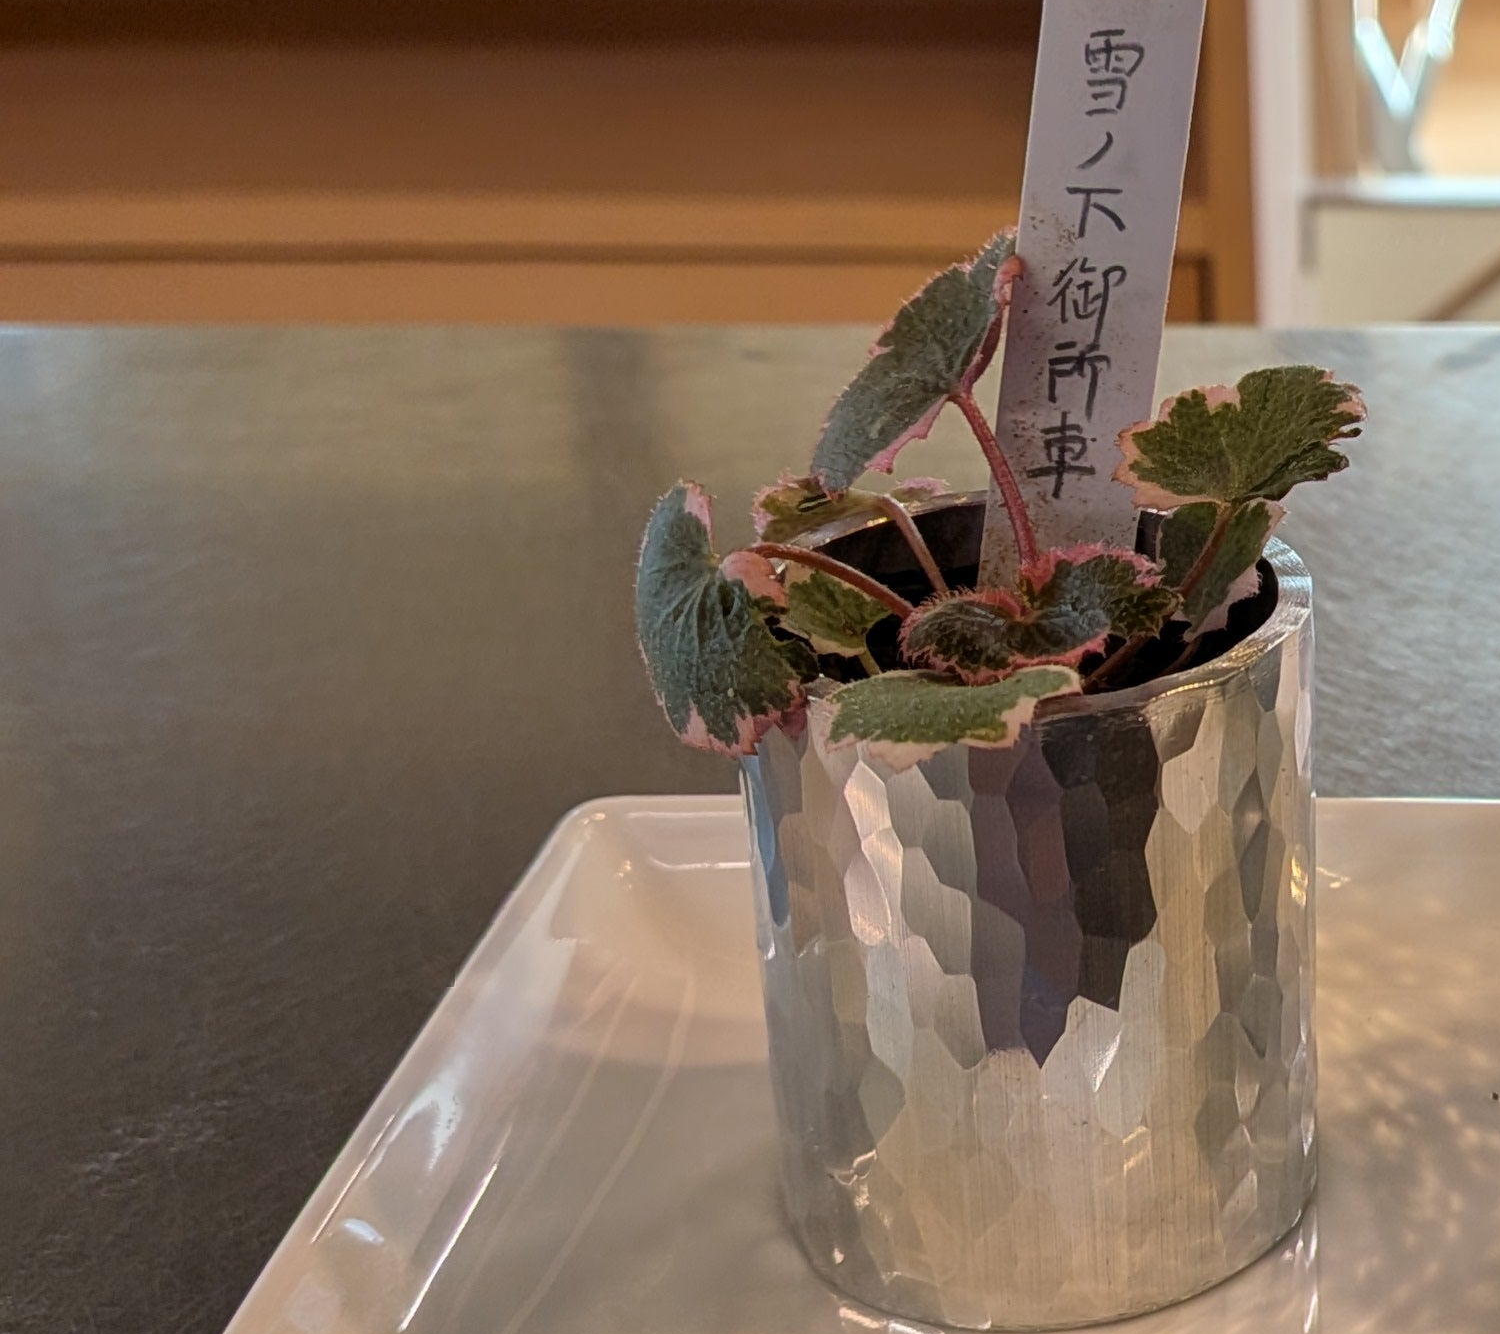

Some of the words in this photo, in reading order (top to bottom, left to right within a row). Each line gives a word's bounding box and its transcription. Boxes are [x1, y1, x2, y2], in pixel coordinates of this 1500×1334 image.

[1026, 28, 1144, 499] 雪ノ下御所車
